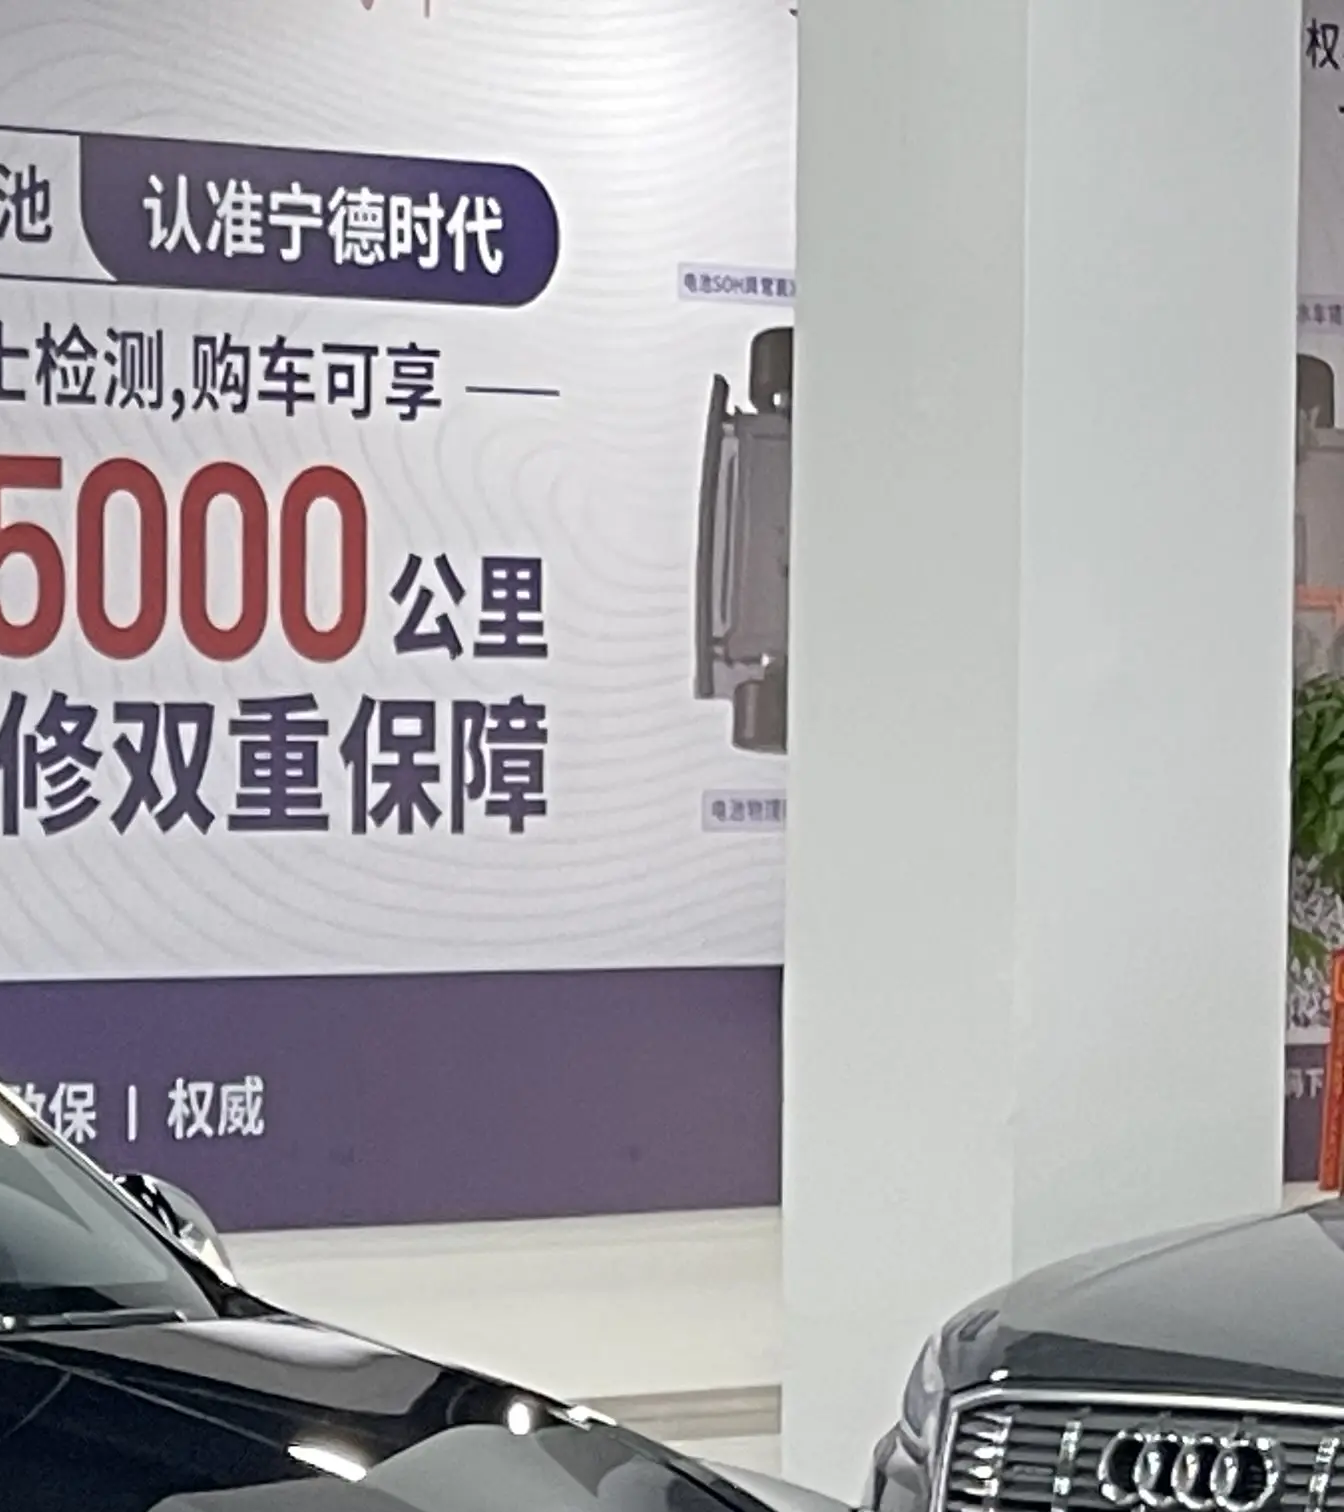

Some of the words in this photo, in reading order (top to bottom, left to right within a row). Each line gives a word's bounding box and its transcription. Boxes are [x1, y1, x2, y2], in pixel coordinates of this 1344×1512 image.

[142, 174, 503, 275] 认准宁德时代
[390, 552, 548, 661] 公里
[168, 1076, 266, 1139] 权威
